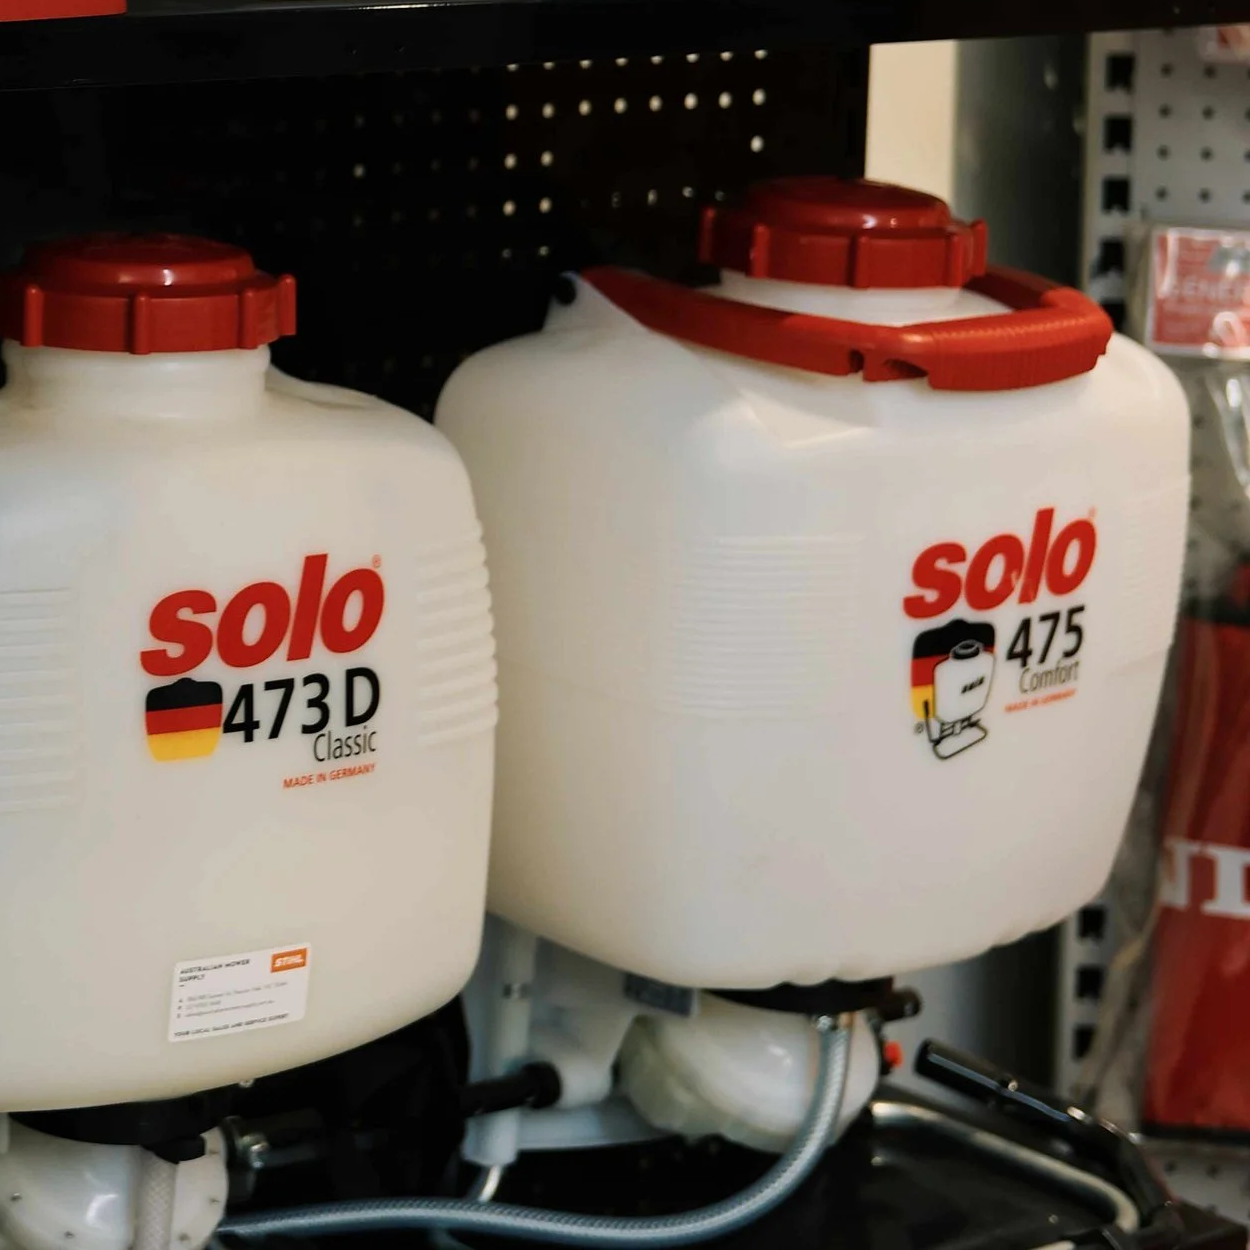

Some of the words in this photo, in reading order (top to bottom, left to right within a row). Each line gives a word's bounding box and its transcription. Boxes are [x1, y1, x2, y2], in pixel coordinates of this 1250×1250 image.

[903, 507, 1097, 620] solo
[140, 553, 385, 677] solo
[1005, 604, 1085, 668] 475
[1019, 660, 1080, 694] Comfort
[313, 725, 377, 762] Classic
[282, 774, 314, 790] MADE
[316, 771, 327, 783] IN
[329, 763, 376, 781] GERMANY
